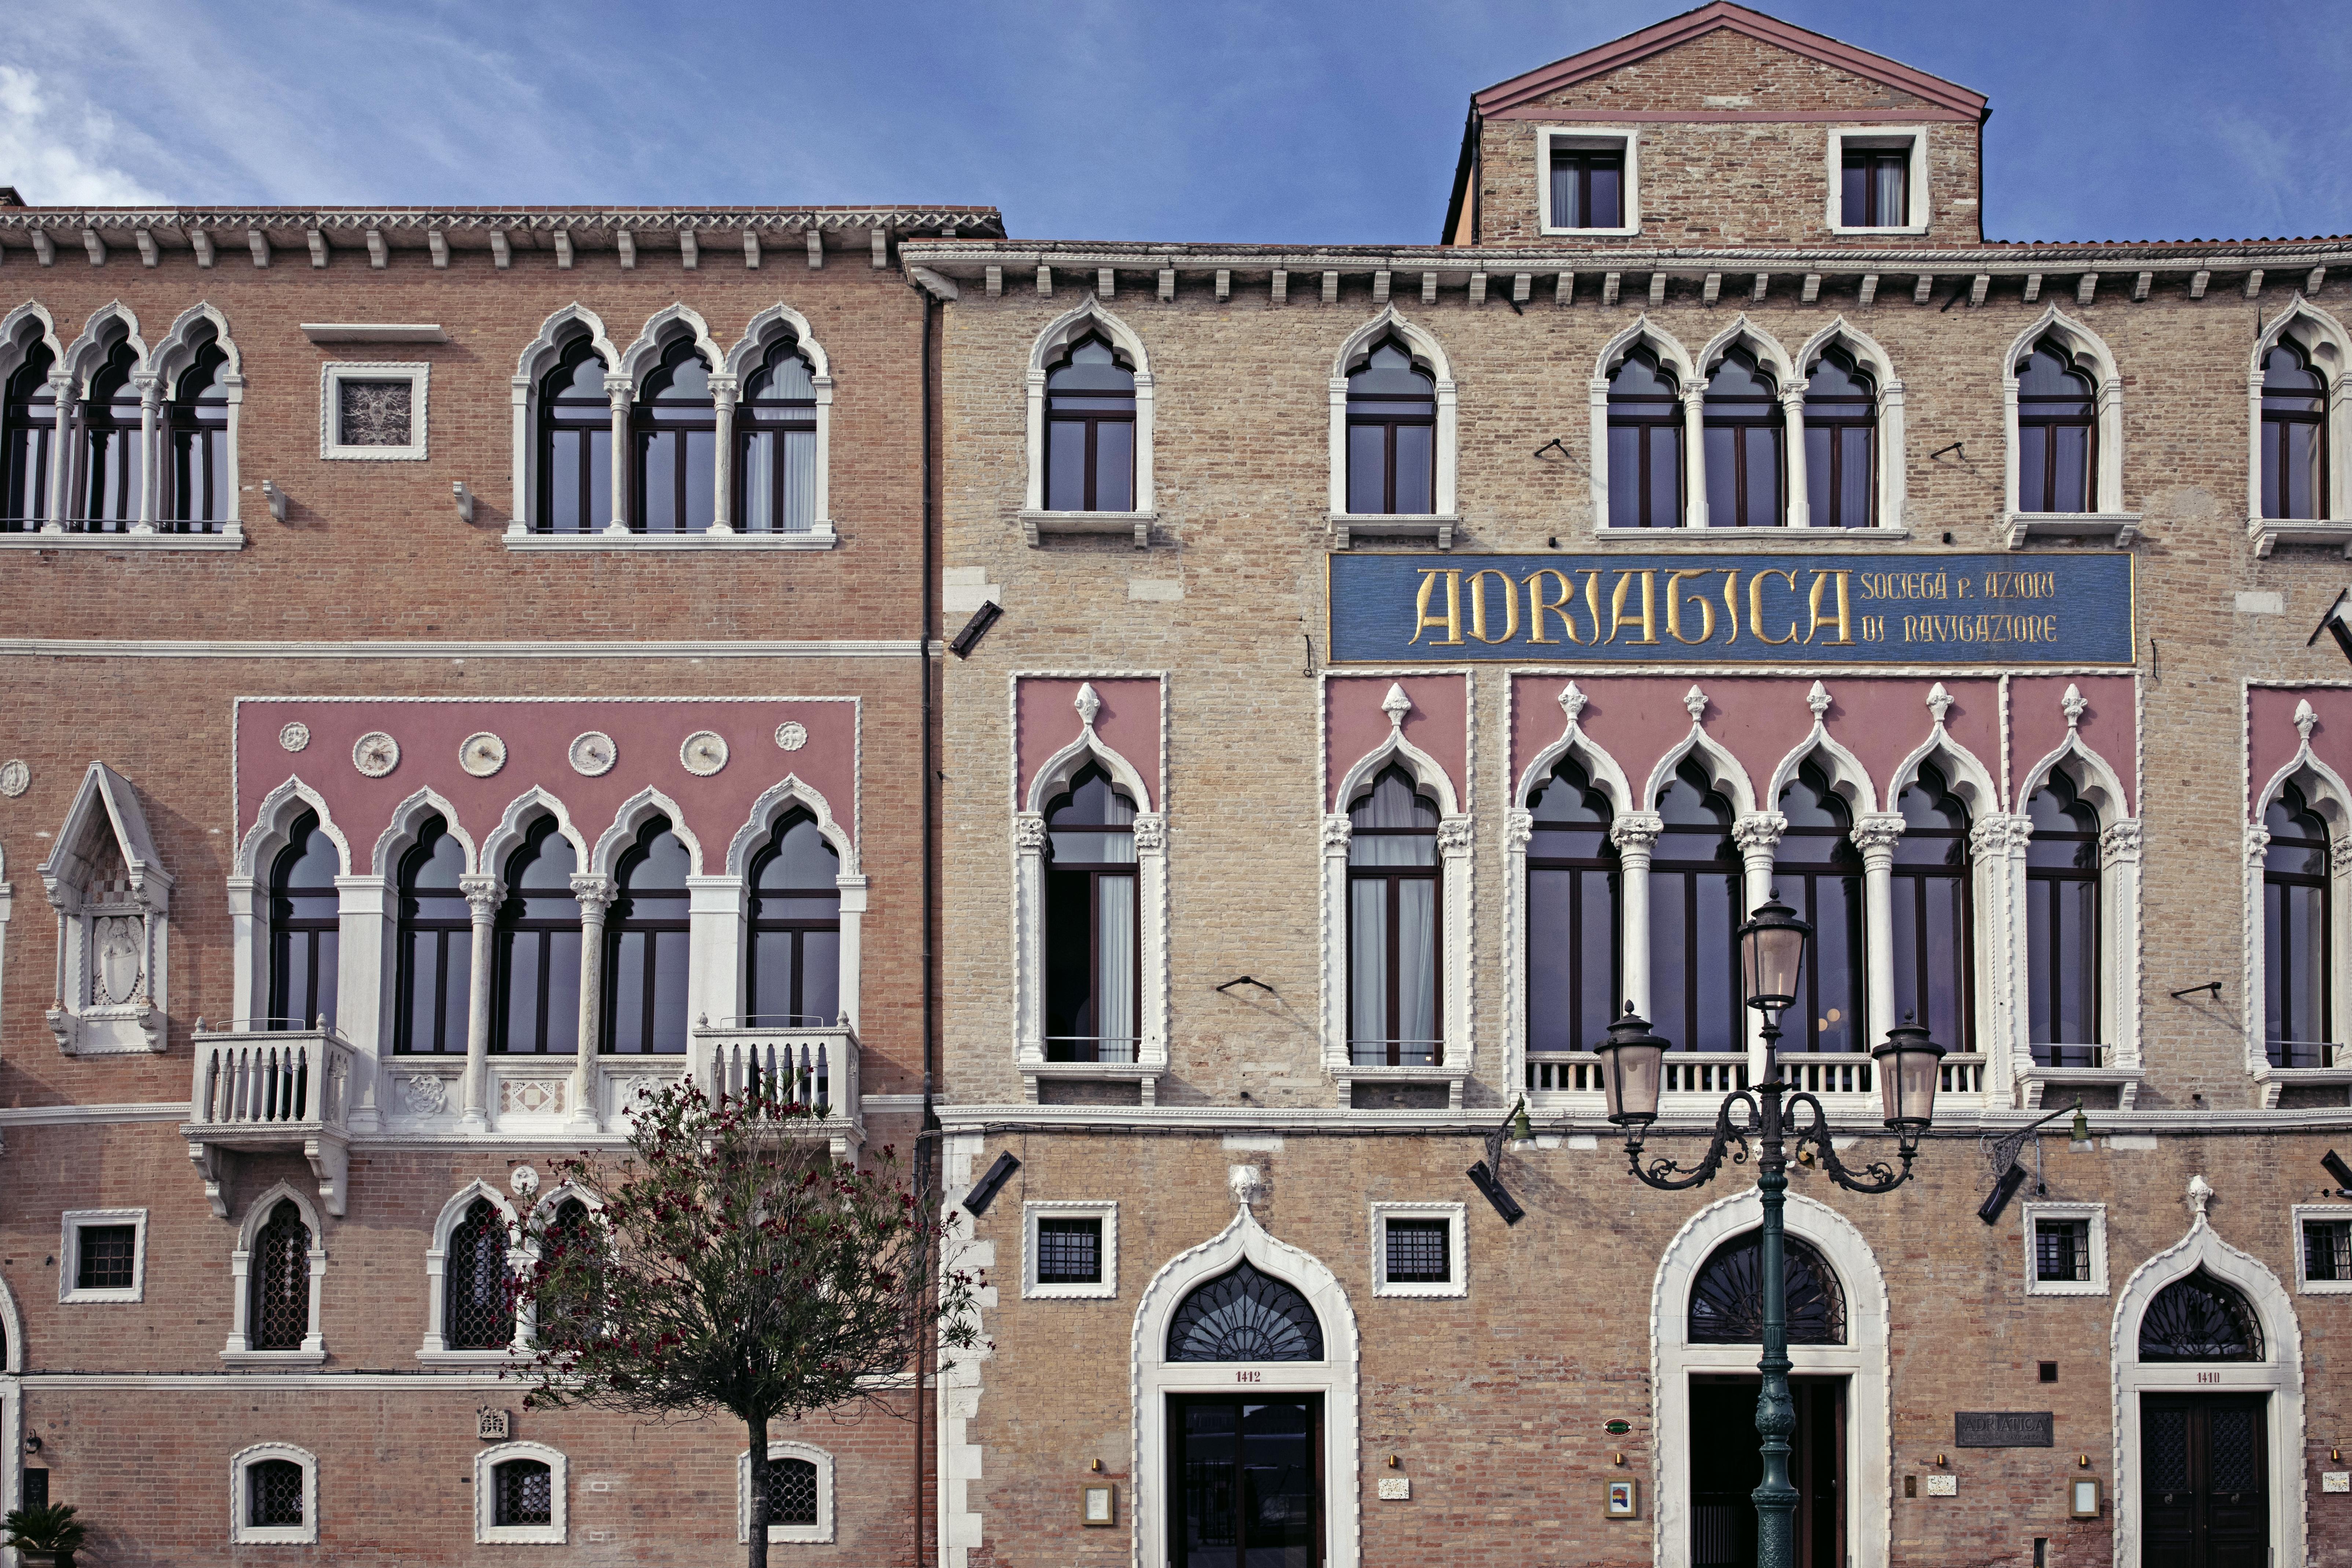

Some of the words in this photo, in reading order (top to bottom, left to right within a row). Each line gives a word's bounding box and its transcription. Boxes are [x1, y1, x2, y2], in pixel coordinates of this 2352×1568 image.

[1985, 572, 2055, 598] AZIONI
[1408, 569, 1856, 646] ADRIATICA
[1862, 616, 1885, 642] DI
[1903, 615, 2058, 642] NAVIGAZIONE
[1235, 1371, 1261, 1382] 1412
[2197, 1372, 2220, 1383] 1410
[1963, 1418, 2043, 1431] ADRIATICA
